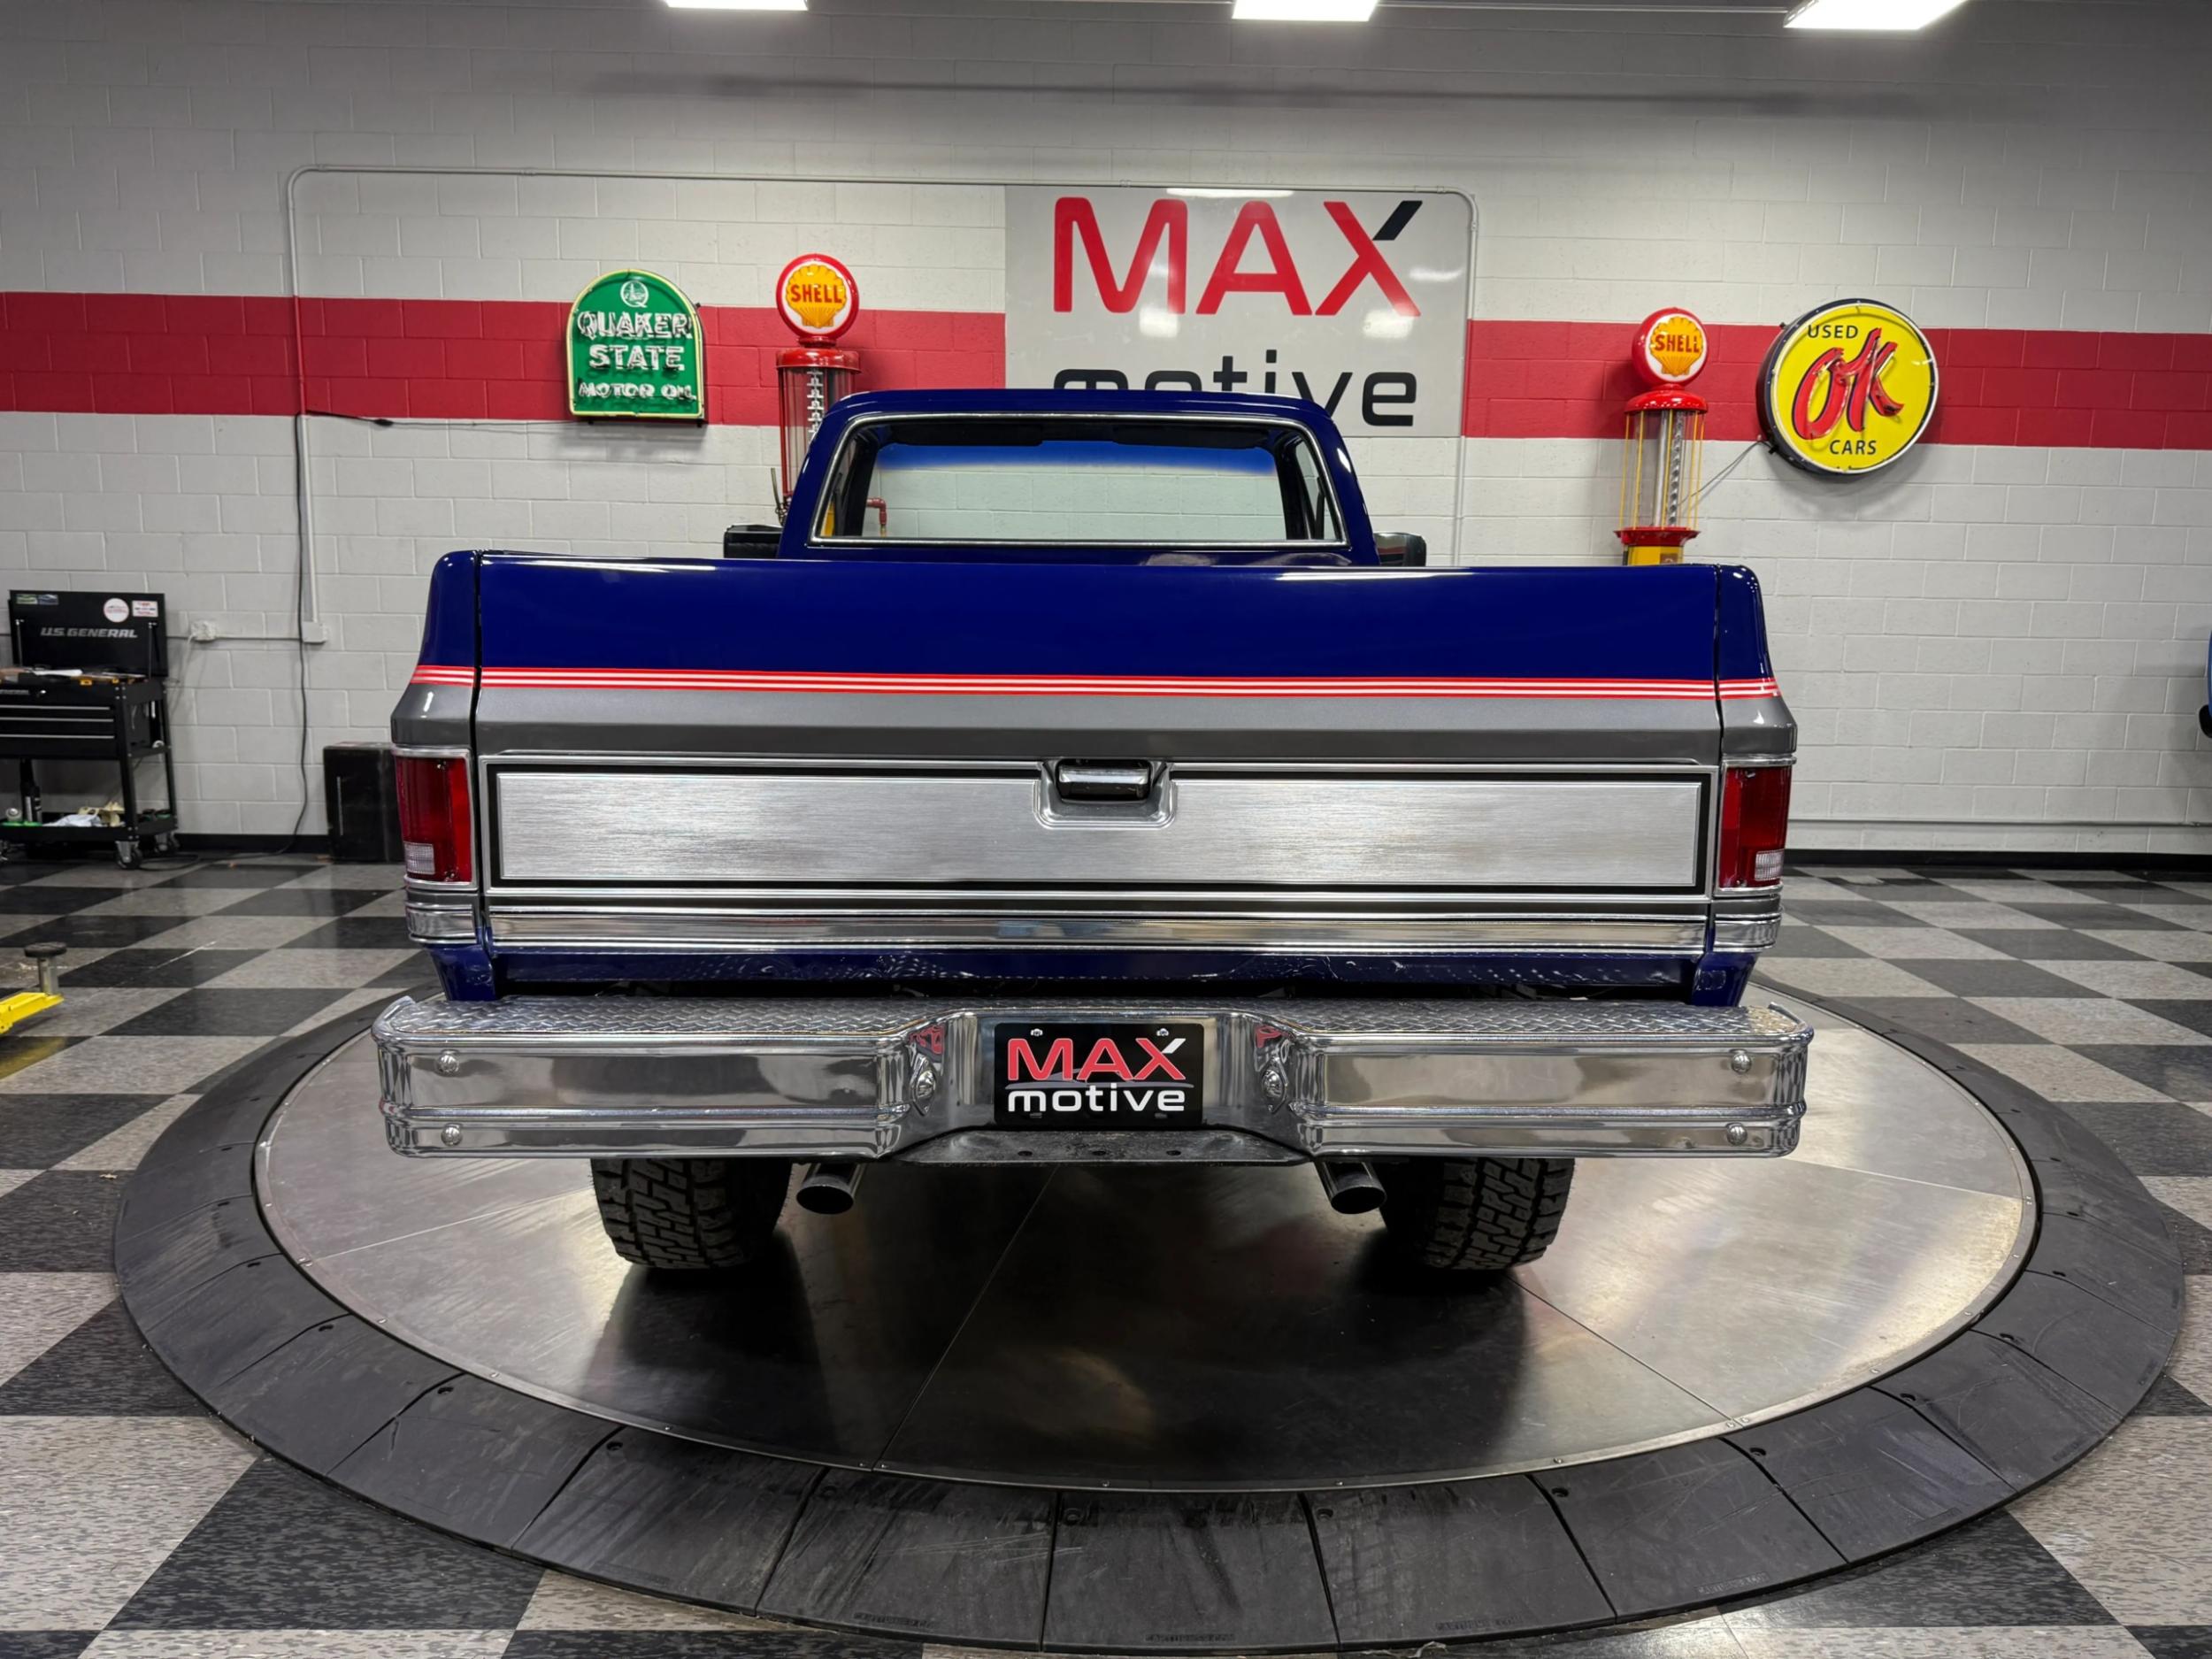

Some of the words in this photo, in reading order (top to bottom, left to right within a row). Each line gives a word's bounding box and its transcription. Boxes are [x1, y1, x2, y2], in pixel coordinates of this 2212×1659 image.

[1054, 196, 1423, 317] MAX
[790, 284, 843, 304] SHELL
[577, 311, 693, 340] QUAKER
[1807, 324, 1859, 340] USED
[1655, 334, 1701, 354] SHELL
[589, 344, 685, 371] STATE
[579, 382, 656, 399] MOTOR
[661, 384, 697, 401] OIL
[1792, 327, 1904, 441] OK
[1830, 439, 1878, 456] CARS
[67, 627, 138, 638] GENERAL
[1008, 1038, 1187, 1081] MAX
[1008, 1082, 1186, 1112] motive
